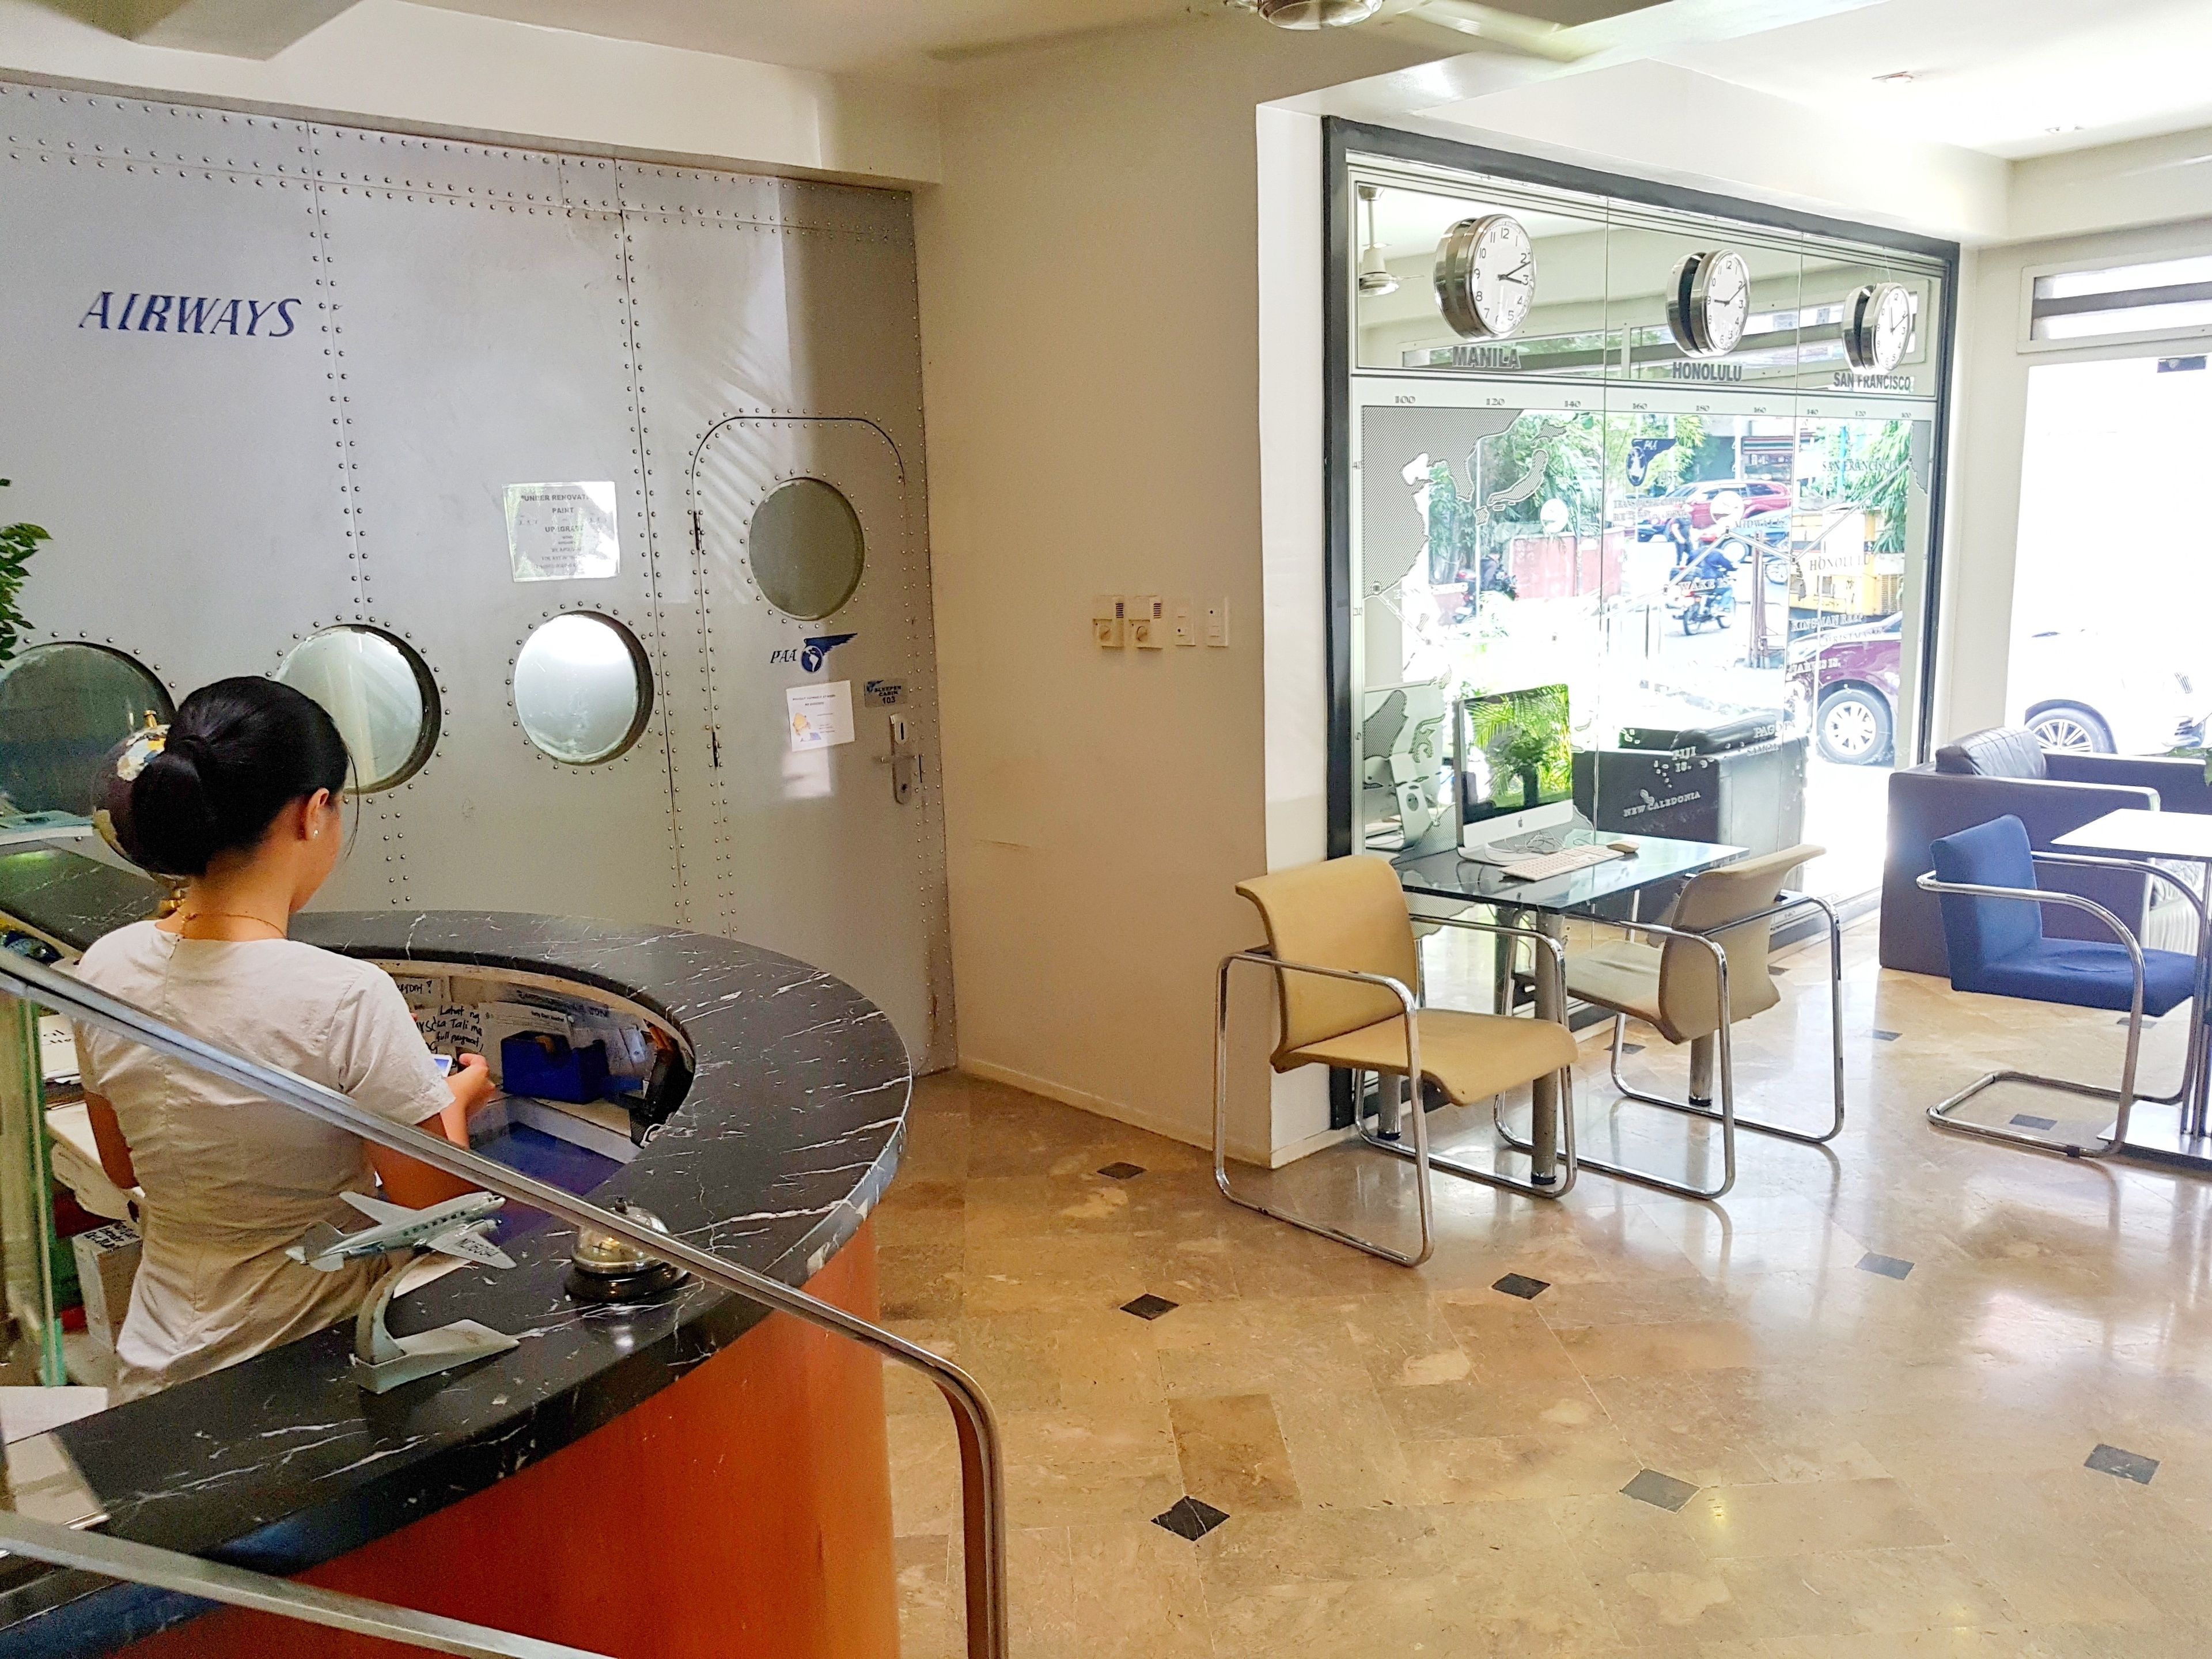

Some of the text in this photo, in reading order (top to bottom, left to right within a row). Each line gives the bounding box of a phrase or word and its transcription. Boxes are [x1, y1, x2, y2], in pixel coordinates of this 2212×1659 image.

[1501, 227, 1509, 239] 12
[1479, 247, 1487, 259] 10
[78, 290, 302, 338] AIRWAYS
[1452, 346, 1521, 369] MANILA
[1672, 362, 1743, 382] HONOLULU
[1833, 372, 1911, 392] SAN FRANCISCO
[1395, 395, 1416, 404] 100
[1486, 397, 1505, 406] 120
[1565, 400, 1581, 408] 140
[1822, 460, 1840, 472] SAN
[770, 649, 798, 664] PAA
[882, 696, 896, 704] 103
[1747, 744, 1779, 757] SAMOA
[1623, 791, 1702, 818] NEW CALEDONIA
